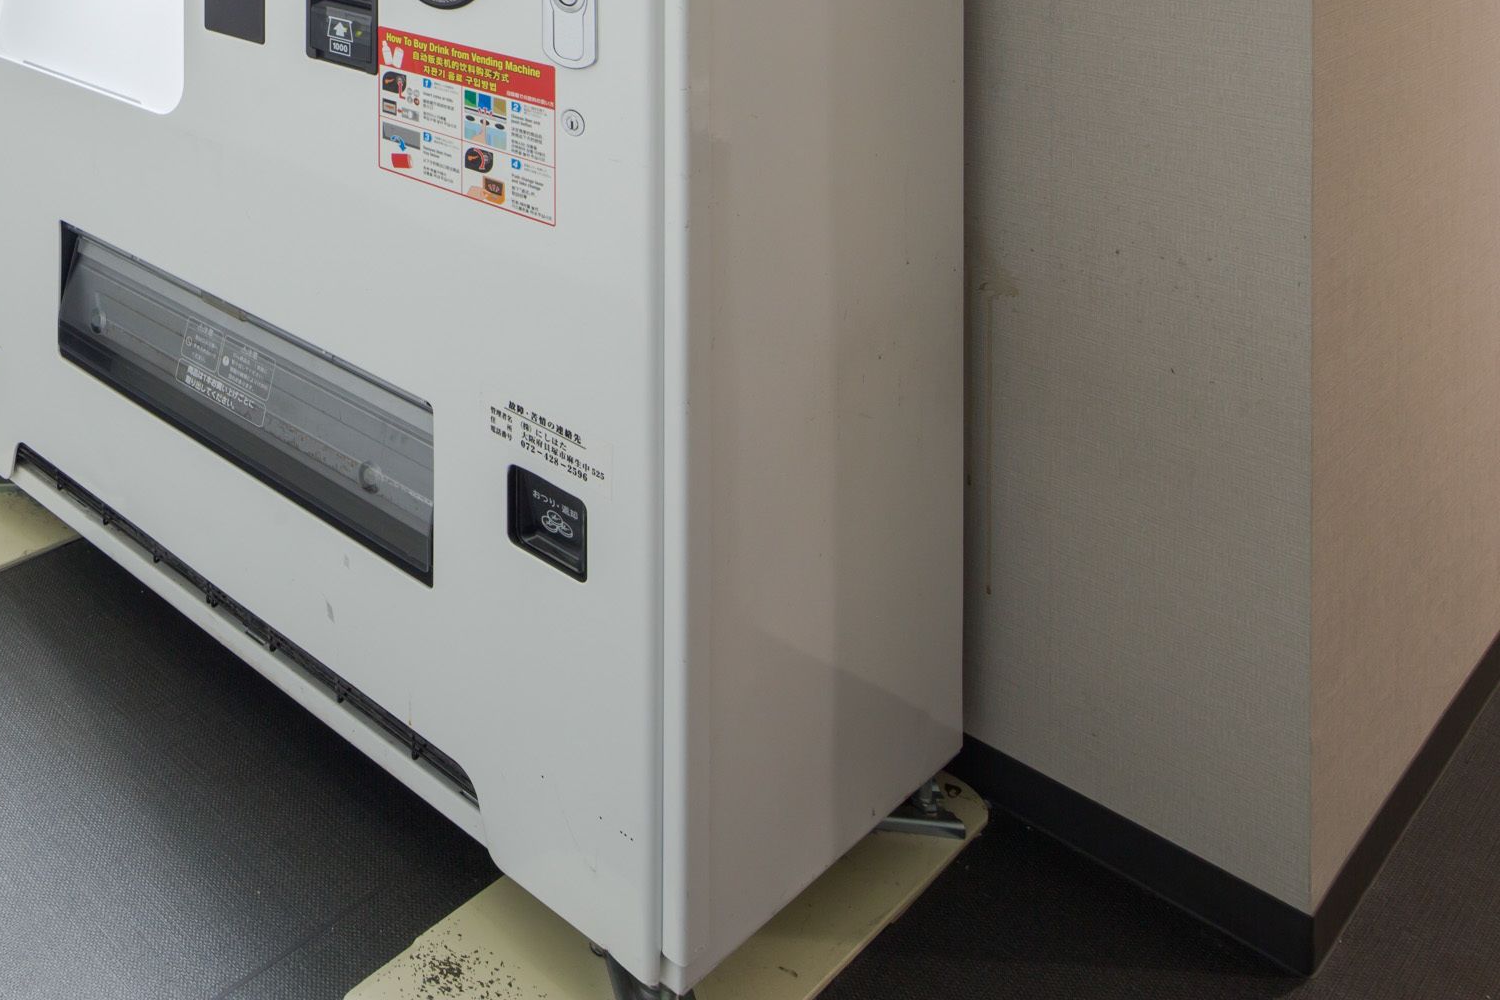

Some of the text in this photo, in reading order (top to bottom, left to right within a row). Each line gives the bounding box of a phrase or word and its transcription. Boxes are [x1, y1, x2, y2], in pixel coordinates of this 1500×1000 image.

[332, 42, 348, 53] 1000
[386, 32, 541, 79] How To Buy Drink from Vending Machine
[423, 66, 497, 93] 자판기 음료 구입방법
